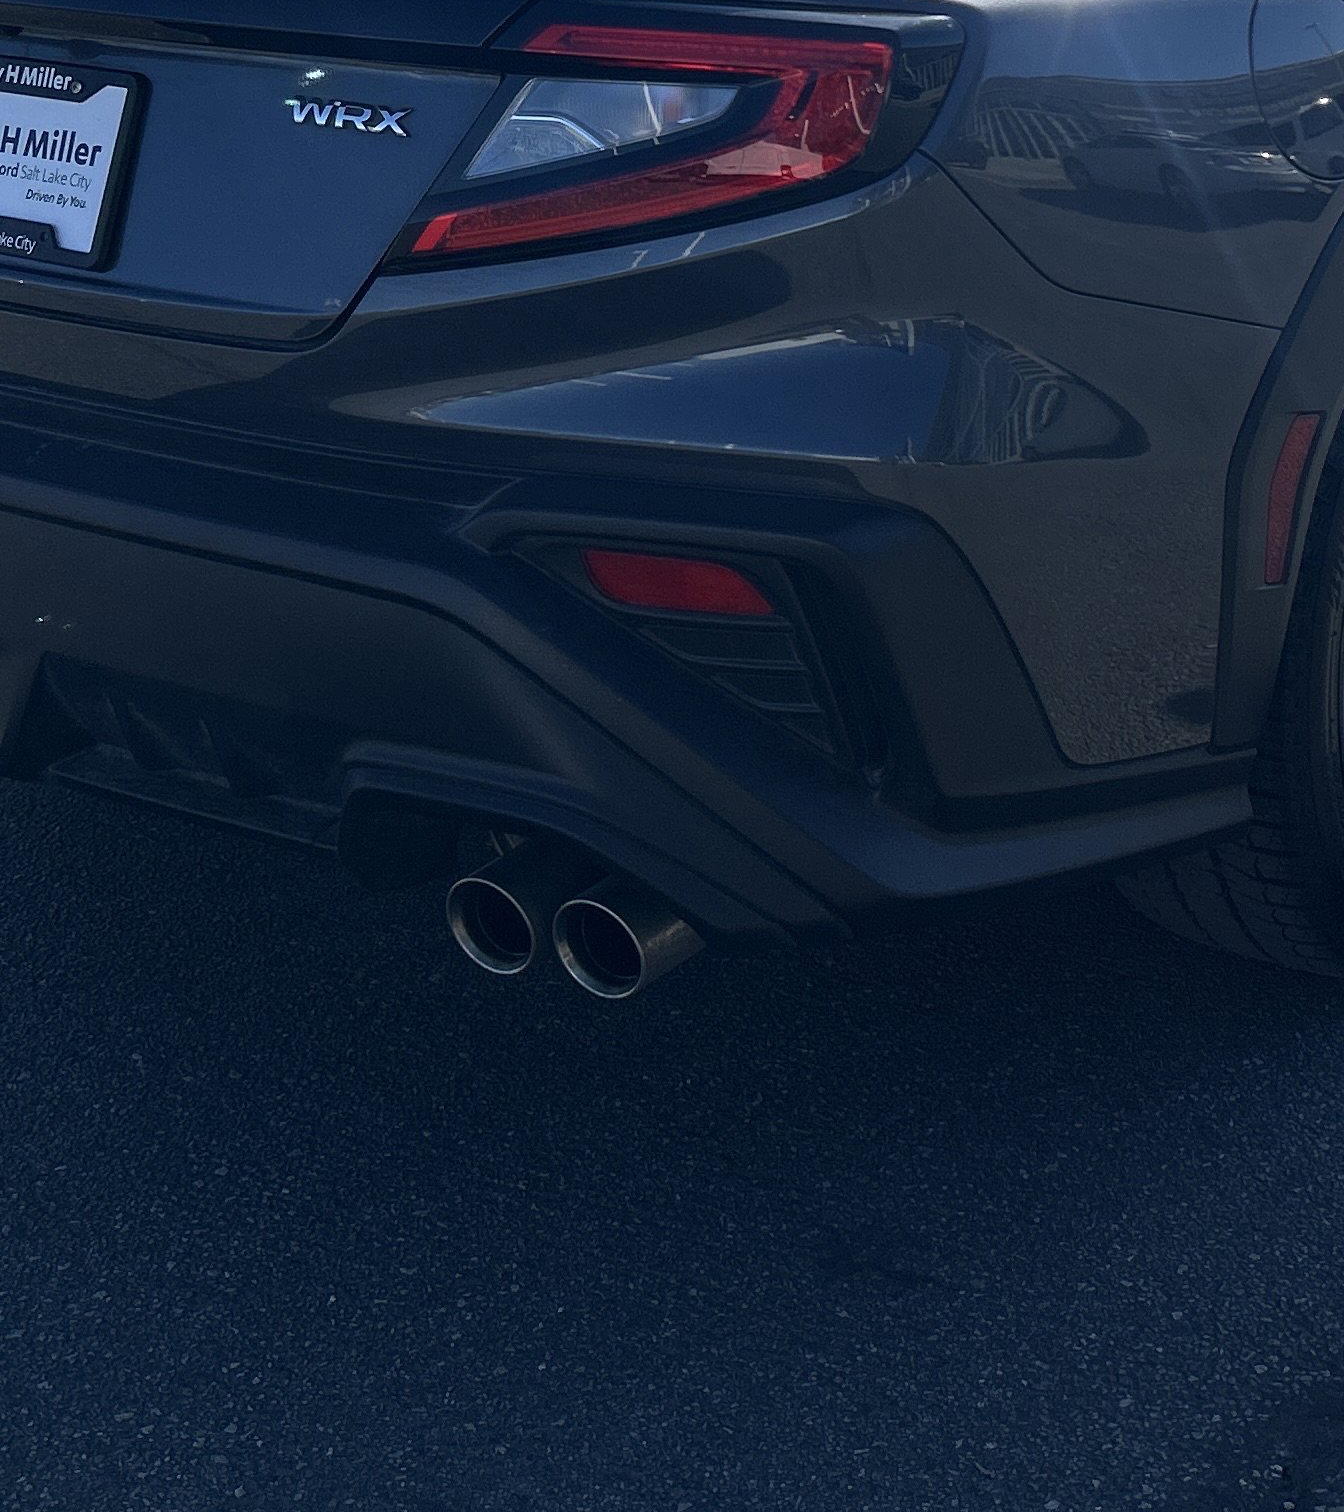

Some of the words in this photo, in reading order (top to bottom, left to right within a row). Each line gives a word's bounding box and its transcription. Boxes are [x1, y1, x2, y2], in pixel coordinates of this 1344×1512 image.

[6, 64, 20, 84] H
[21, 65, 72, 91] Miller
[284, 98, 412, 137] WRX
[0, 125, 21, 155] H
[23, 128, 102, 167] Miller
[20, 165, 40, 182] Salt
[42, 168, 68, 186] Lake
[69, 172, 92, 192] City
[26, 189, 55, 203] Driven
[57, 192, 69, 207] By
[15, 234, 36, 254] City
